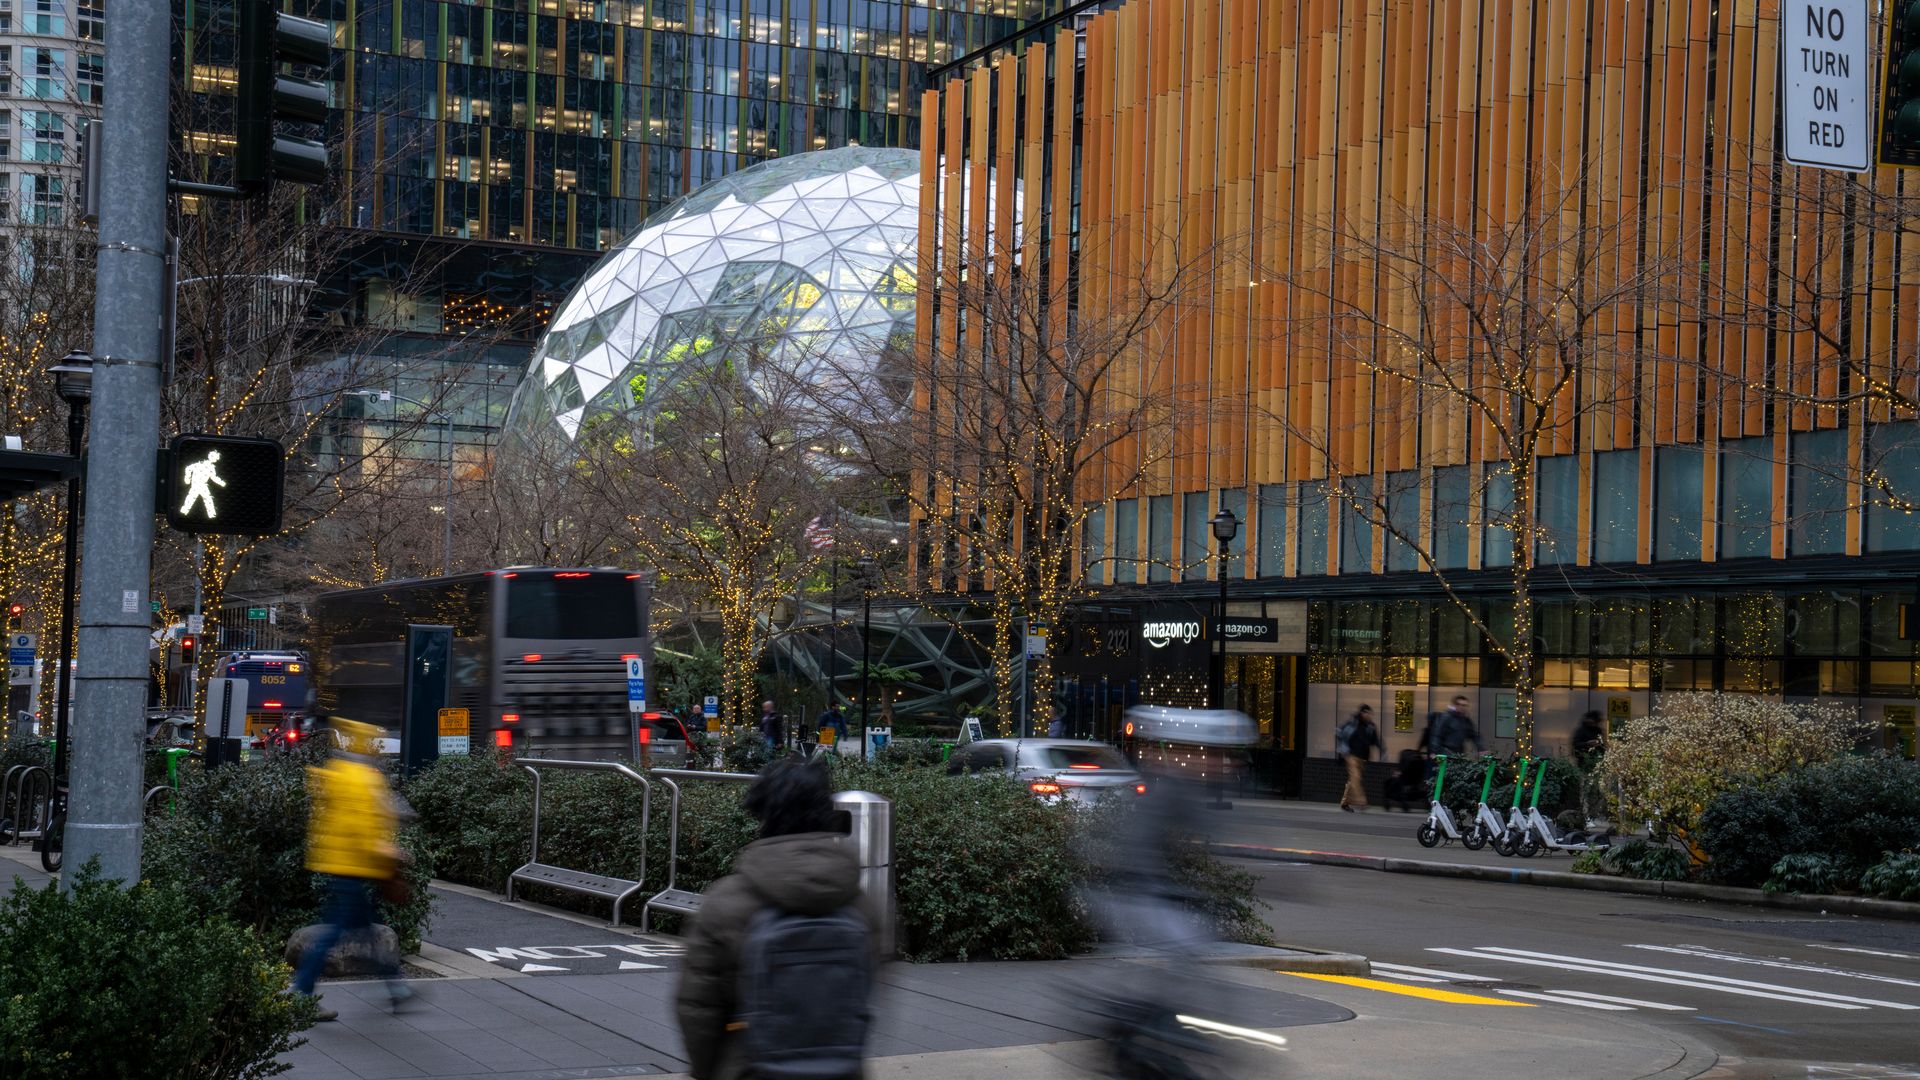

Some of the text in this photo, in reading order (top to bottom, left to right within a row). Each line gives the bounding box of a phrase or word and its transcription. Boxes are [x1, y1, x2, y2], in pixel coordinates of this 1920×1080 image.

[1806, 4, 1845, 42] NO
[1800, 48, 1850, 78] TURN
[1813, 85, 1838, 112] ON
[1809, 120, 1844, 148] RED
[1107, 629, 1129, 650] 2121
[1143, 622, 1182, 638] amazon
[261, 675, 286, 684] 8052
[290, 664, 300, 672] 62
